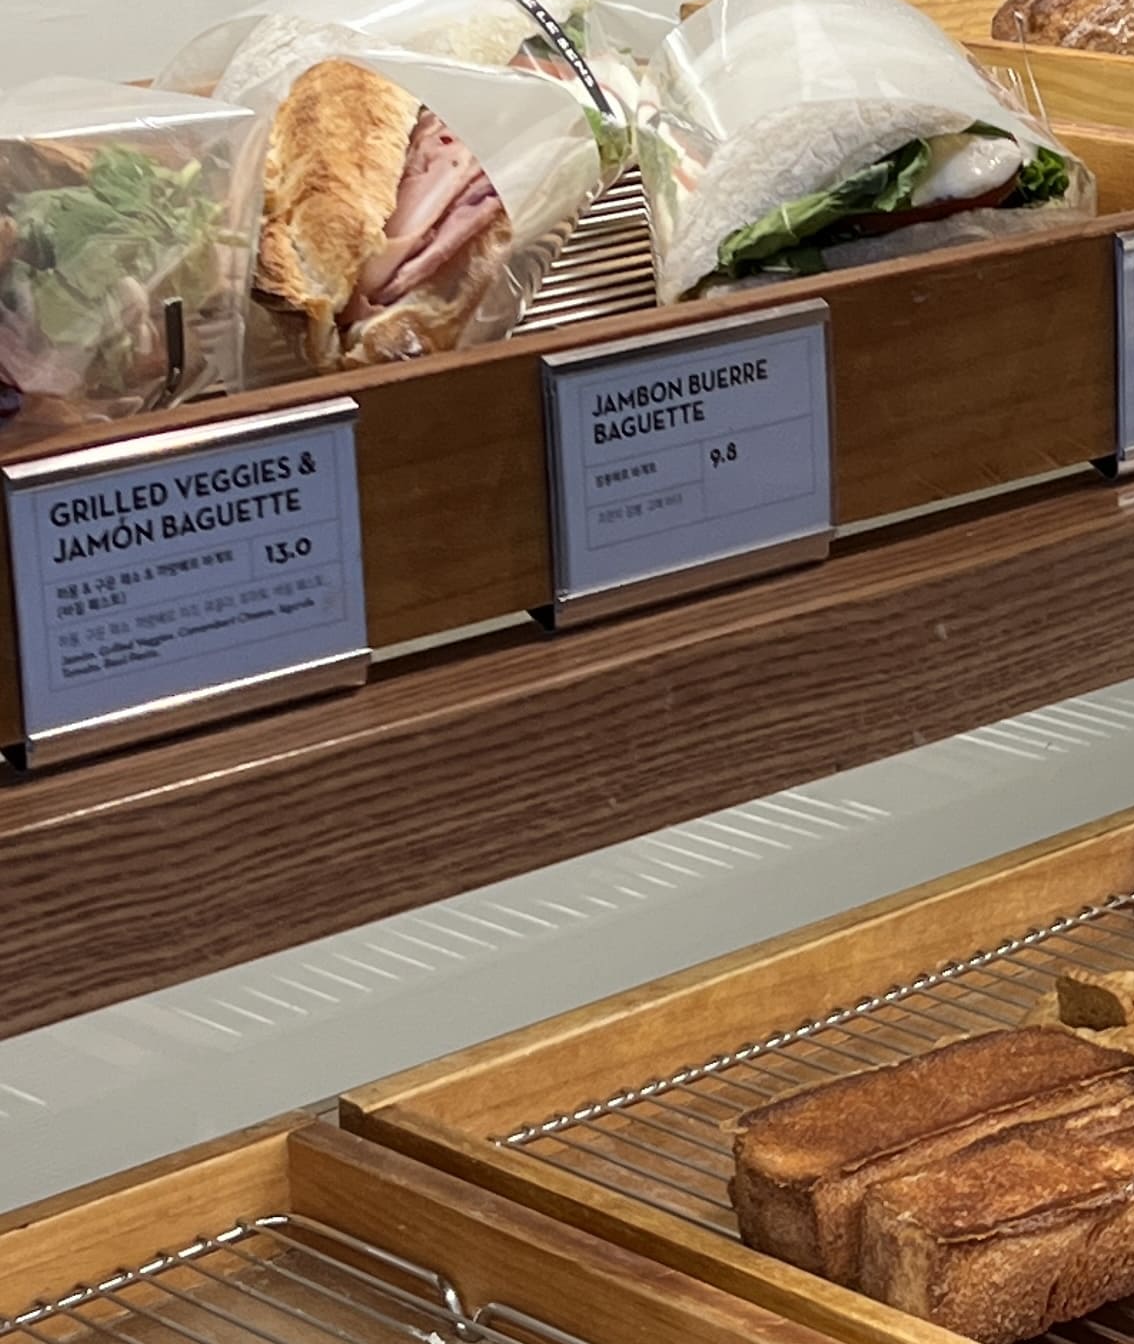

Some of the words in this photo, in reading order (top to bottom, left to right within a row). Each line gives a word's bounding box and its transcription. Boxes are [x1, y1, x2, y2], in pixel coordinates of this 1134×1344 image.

[592, 377, 683, 418] JAMBON
[689, 359, 768, 396] BUERRE
[594, 401, 705, 445] BAGUETTE
[710, 442, 738, 469] 9.8
[50, 483, 168, 528] GRILLED
[174, 456, 292, 499] VEGGIES
[297, 451, 317, 475] &
[53, 517, 154, 564] JAMÓN
[162, 488, 302, 540] BAGUETTE
[265, 537, 312, 565] 13.0
